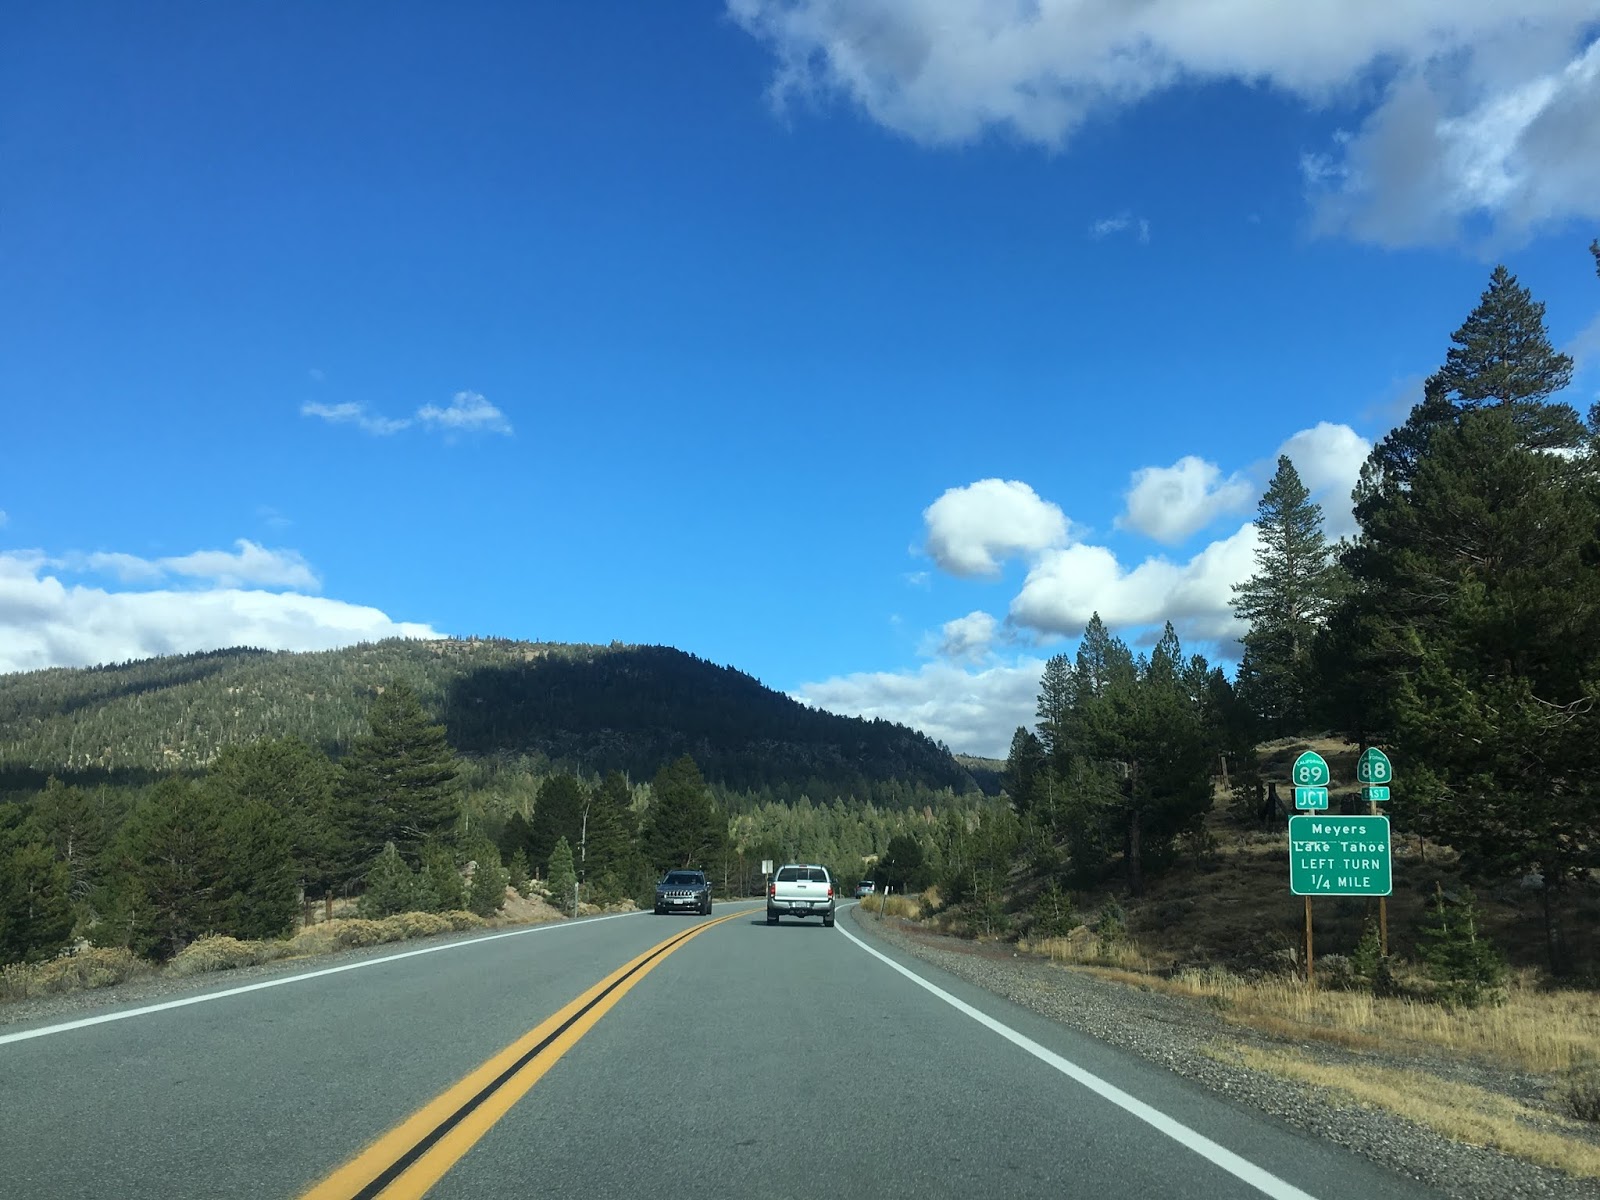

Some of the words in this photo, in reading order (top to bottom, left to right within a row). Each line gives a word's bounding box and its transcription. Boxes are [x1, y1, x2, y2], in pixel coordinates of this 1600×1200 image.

[1300, 767, 1322, 782] 89
[1362, 762, 1386, 778] 88
[1299, 791, 1324, 806] JCT
[1364, 789, 1385, 798] EAST
[1312, 824, 1367, 836] Meyers
[1295, 841, 1330, 852] Lake
[1341, 842, 1385, 852] Tahoe
[1302, 859, 1334, 869] LEFT
[1344, 859, 1380, 869] TURN
[1312, 875, 1330, 889] 1/4
[1338, 877, 1370, 887] MILE
